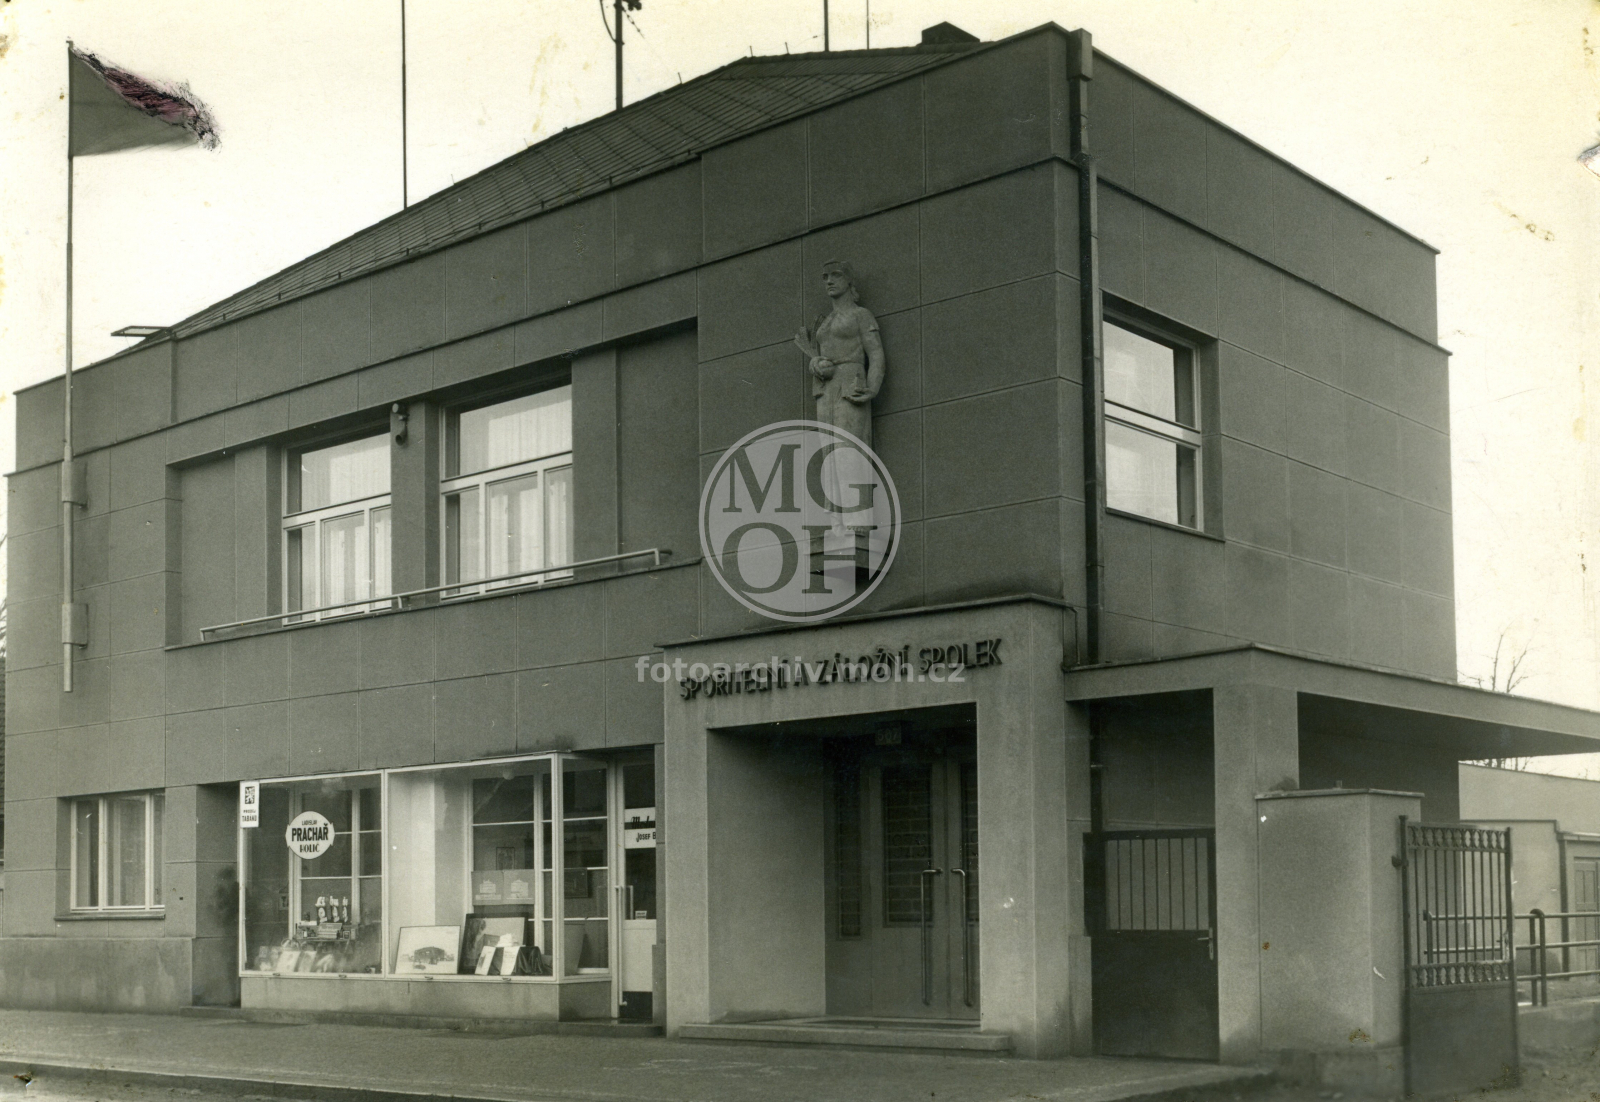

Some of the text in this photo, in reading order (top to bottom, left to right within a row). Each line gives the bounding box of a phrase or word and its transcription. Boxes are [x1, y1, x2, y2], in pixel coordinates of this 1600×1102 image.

[793, 661, 809, 687] A
[918, 638, 1002, 674] SPOLEK
[291, 823, 329, 841] PRACHAŘ
[299, 843, 320, 853] HOLIČ
